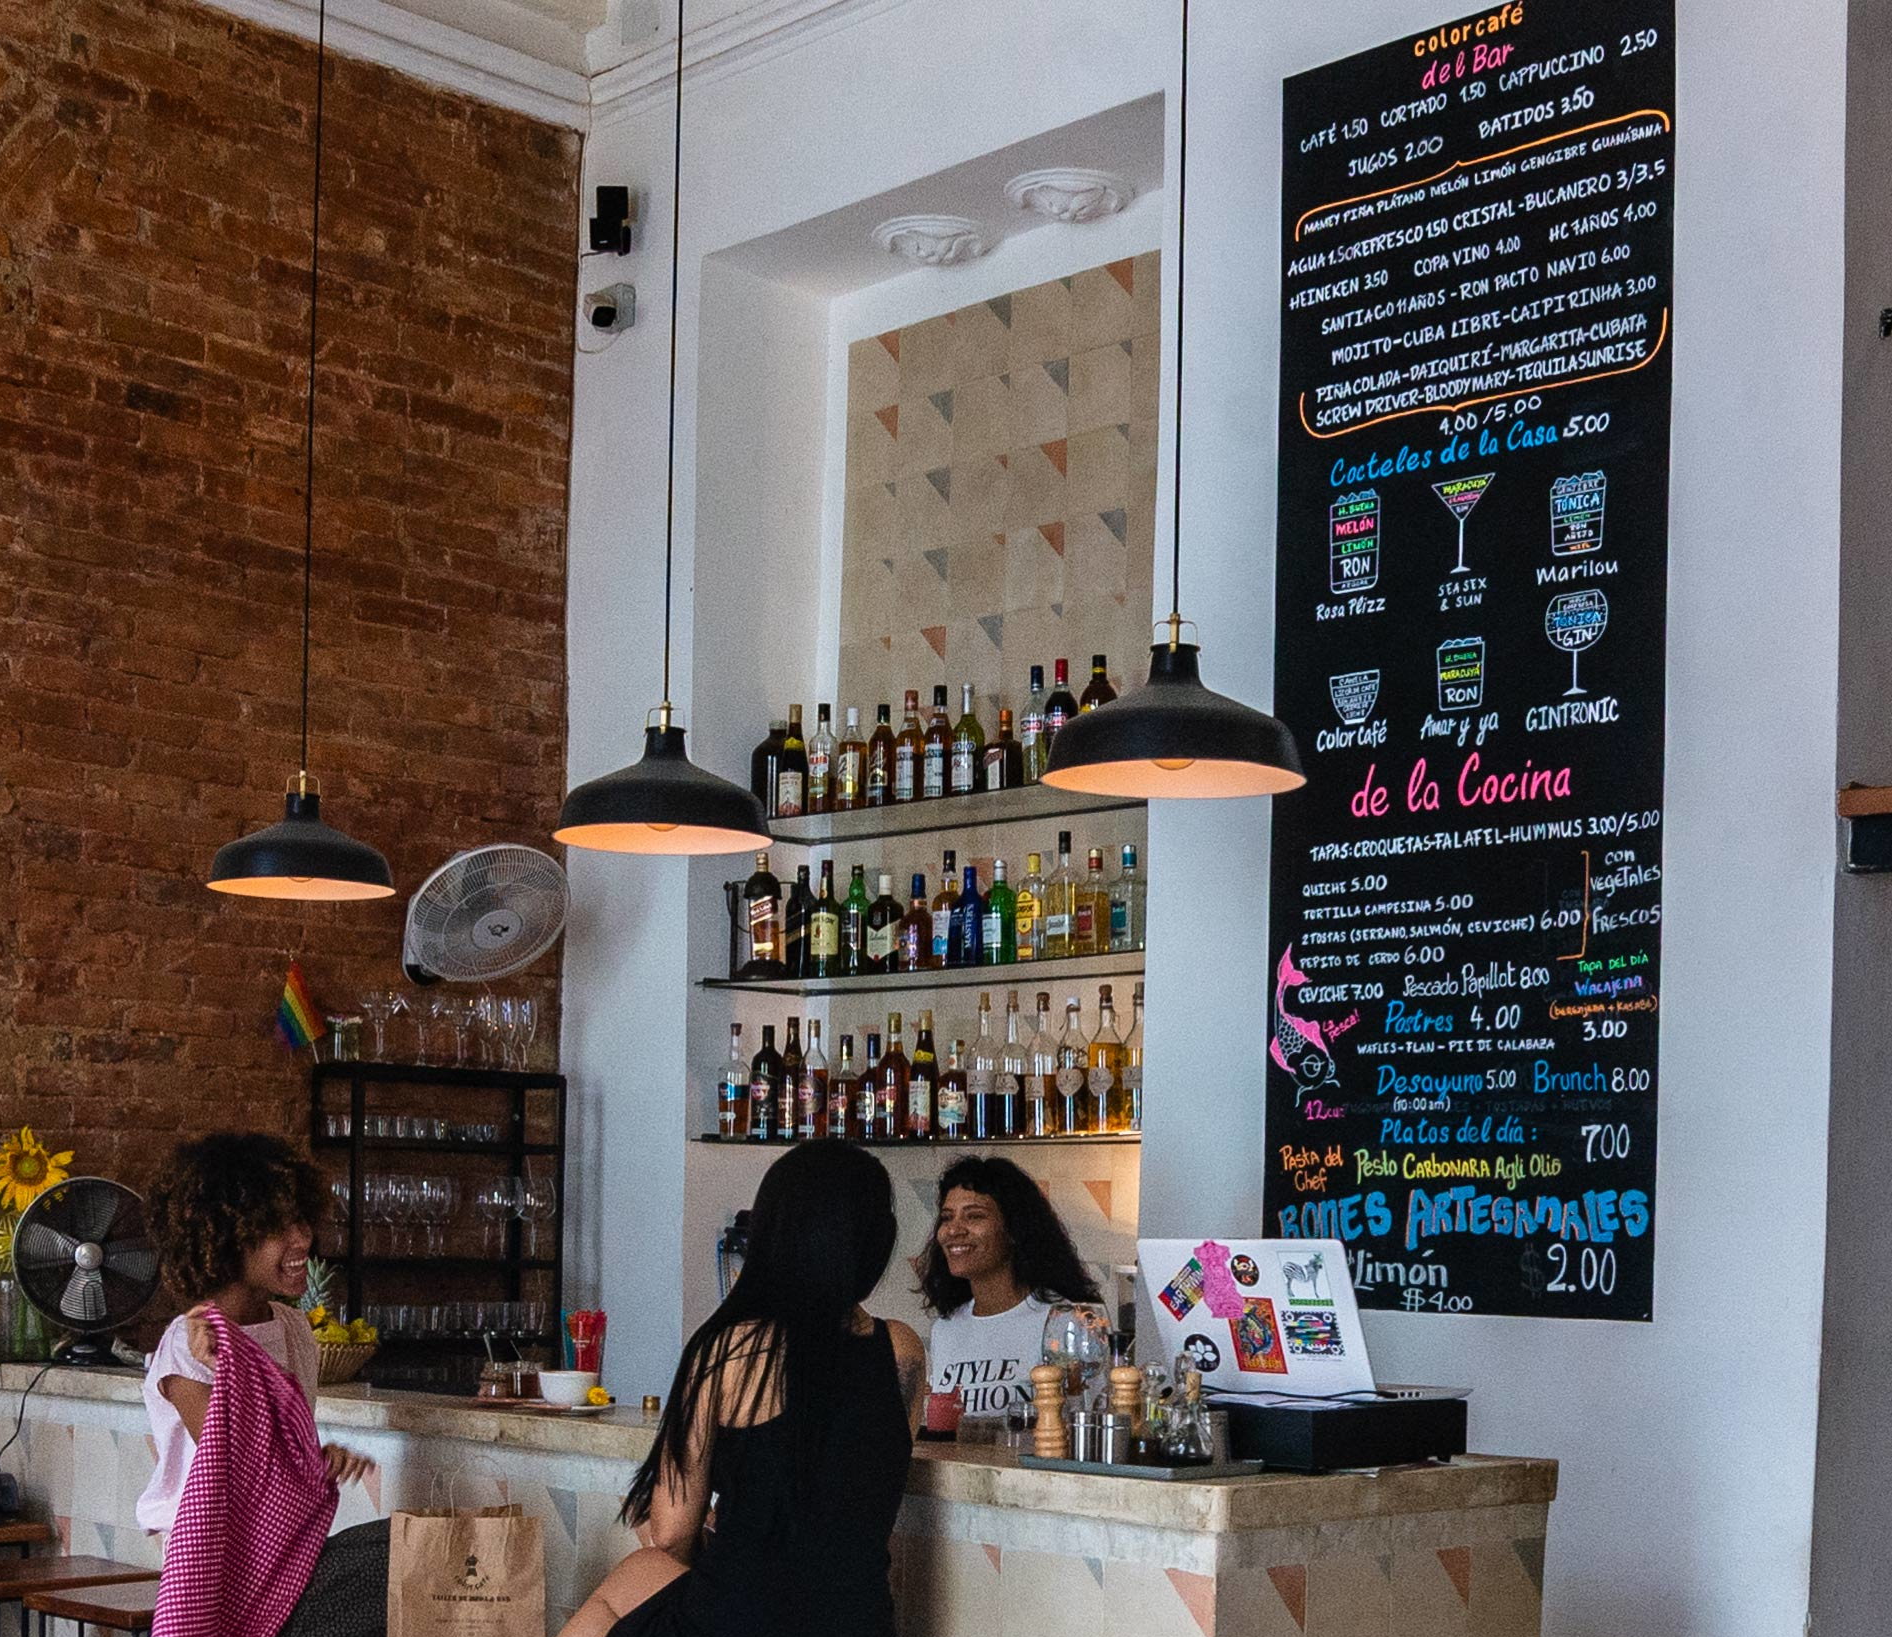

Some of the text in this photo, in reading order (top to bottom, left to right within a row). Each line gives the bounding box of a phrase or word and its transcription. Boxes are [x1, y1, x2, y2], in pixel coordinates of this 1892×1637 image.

[1422, 44, 1515, 90] del Bar
[1300, 28, 1657, 153] CAFÉ 1.50 CORTADO 1.50 CAPPUCCINO 2.50
[1348, 85, 1594, 177] JUGOS 2.00 BATIDOS 3.50
[1377, 193, 1425, 214] PLÁTANO
[1430, 175, 1469, 197] MELÓN
[1475, 162, 1516, 185] LIMÓN
[1521, 143, 1587, 171] GENGIBRE
[1592, 123, 1662, 152] GUANÁBANA
[1287, 253, 1325, 277] AGUA
[1617, 159, 1666, 191] 3/3.5
[1289, 278, 1359, 310] HEINEKEN
[1414, 255, 1449, 277] COPA
[1452, 244, 1490, 267] VINO
[1496, 236, 1521, 255] 4.00
[1549, 222, 1569, 242] HC
[1322, 304, 1394, 335] SANTIAGO
[1495, 267, 1539, 291] PACTO
[1547, 251, 1596, 278] NAVIO
[1601, 245, 1630, 264] 6.00
[1626, 276, 1656, 296] 3.00
[1316, 405, 1361, 427] SCREW
[1331, 413, 1610, 487] Cocteles de la Casa 5.00
[1335, 515, 1374, 536] MELÓN
[1340, 556, 1370, 578] RON
[1536, 559, 1618, 586] Marilou
[1438, 577, 1487, 597] SEA SEX
[1455, 594, 1482, 607] SUN
[1316, 604, 1345, 621] Rosa
[1563, 628, 1592, 646] GIN
[1445, 686, 1477, 703] RON
[1526, 696, 1620, 732] GINTRONIC
[1317, 719, 1387, 752] Color Café
[1421, 712, 1499, 746] Amar y ya
[1351, 752, 1571, 817] de la Cocina
[1605, 850, 1635, 866] con
[1302, 875, 1388, 897] QUICHE 5.00
[1303, 894, 1474, 920] TORTILLA CAMPESINA 5.00
[1540, 909, 1581, 930] 6.00
[1299, 945, 1445, 969] PEPITO DE CERDO 6.00
[1609, 956, 1627, 970] DEL
[1630, 949, 1649, 965] DÍA
[1298, 984, 1348, 1004] CEVICHE
[1351, 983, 1384, 1000] 7.00
[1403, 972, 1459, 997] Pescado
[1461, 961, 1516, 999] Papillot
[1385, 1000, 1521, 1034] Postres 4.00
[1583, 1020, 1627, 1041] 3.00
[1477, 1039, 1492, 1050] DE
[1497, 1038, 1555, 1050] CALABAZA
[1377, 1059, 1650, 1099] Desayuno 5.00 Brunch 8.00
[1380, 1117, 1449, 1144] Platos
[1457, 1115, 1492, 1143] del
[1581, 1123, 1630, 1163] 7.00
[1324, 1144, 1344, 1167] del
[1294, 1168, 1327, 1193] Chef
[1354, 1149, 1398, 1185] Pesto
[1495, 1155, 1527, 1191] Agli
[1547, 1243, 1616, 1295] 2.00
[939, 1359, 1020, 1386] STYLE
[963, 1385, 1034, 1413] HION
